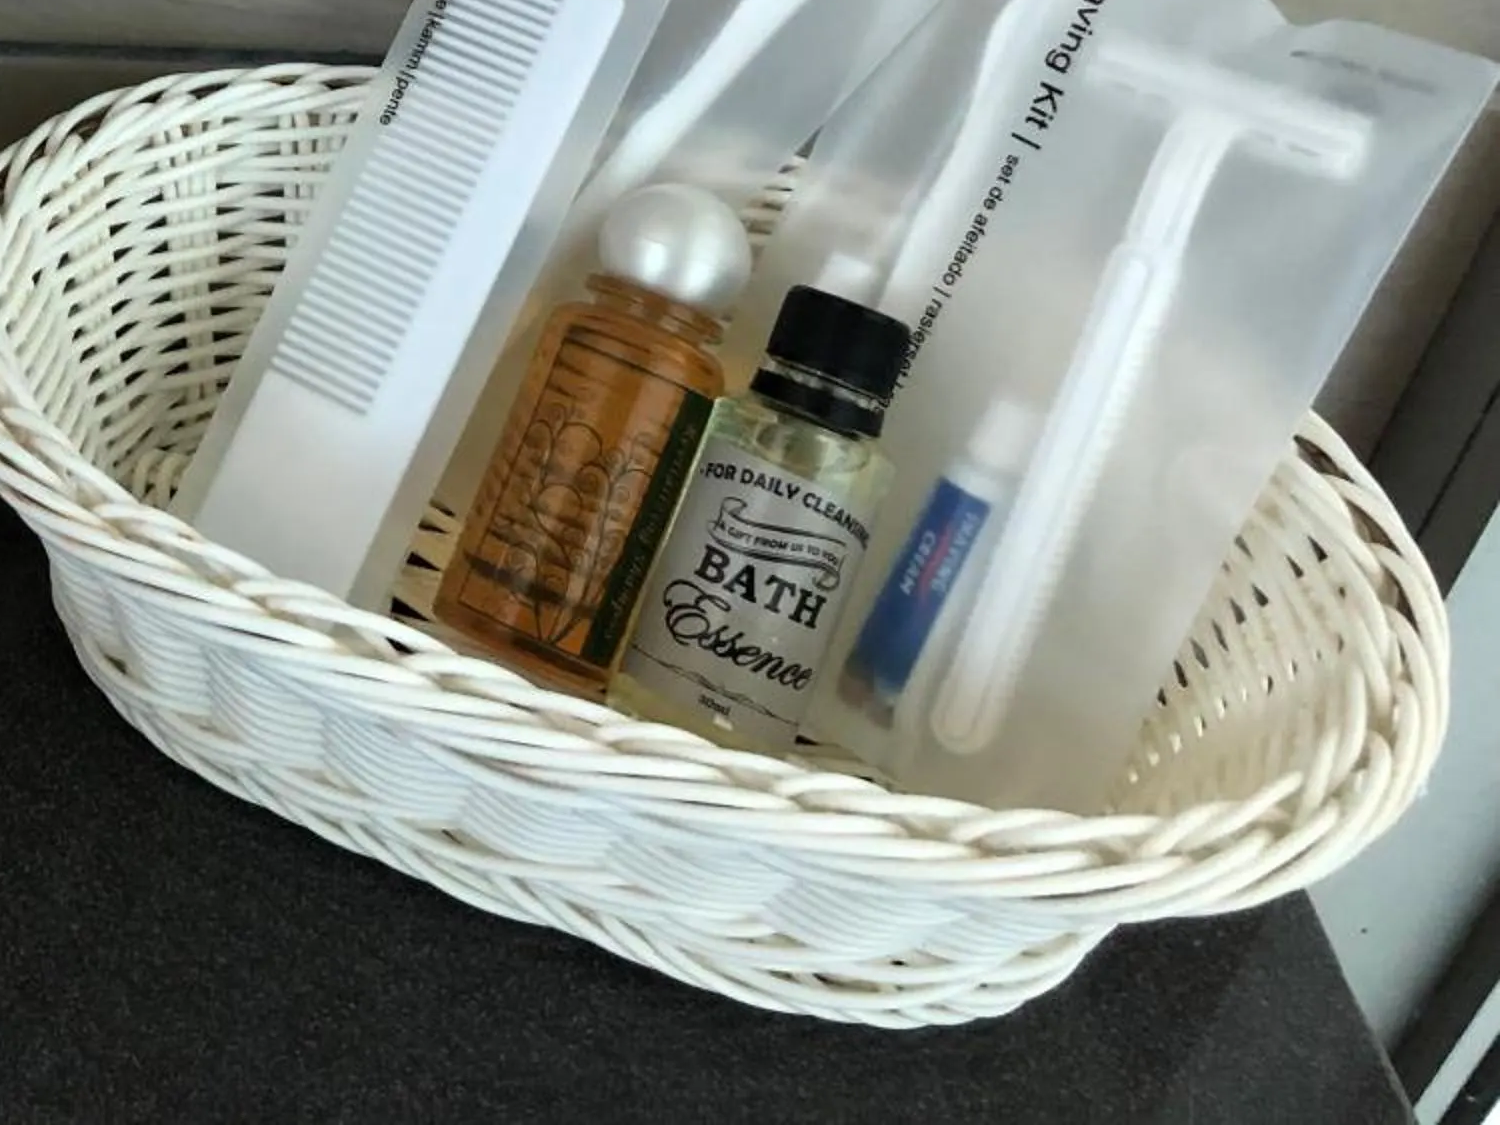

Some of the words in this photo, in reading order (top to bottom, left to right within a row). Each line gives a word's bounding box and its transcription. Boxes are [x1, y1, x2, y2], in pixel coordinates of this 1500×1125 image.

[405, 18, 444, 70] kamm
[379, 76, 410, 126] pente
[1024, 81, 1065, 130] Kit
[996, 154, 1020, 185] set
[982, 185, 1004, 211] de
[942, 212, 989, 287] afeitado
[704, 461, 737, 480] FOR
[739, 468, 800, 500] DAILY
[694, 543, 828, 630] BATH
[663, 578, 814, 692] Essence
